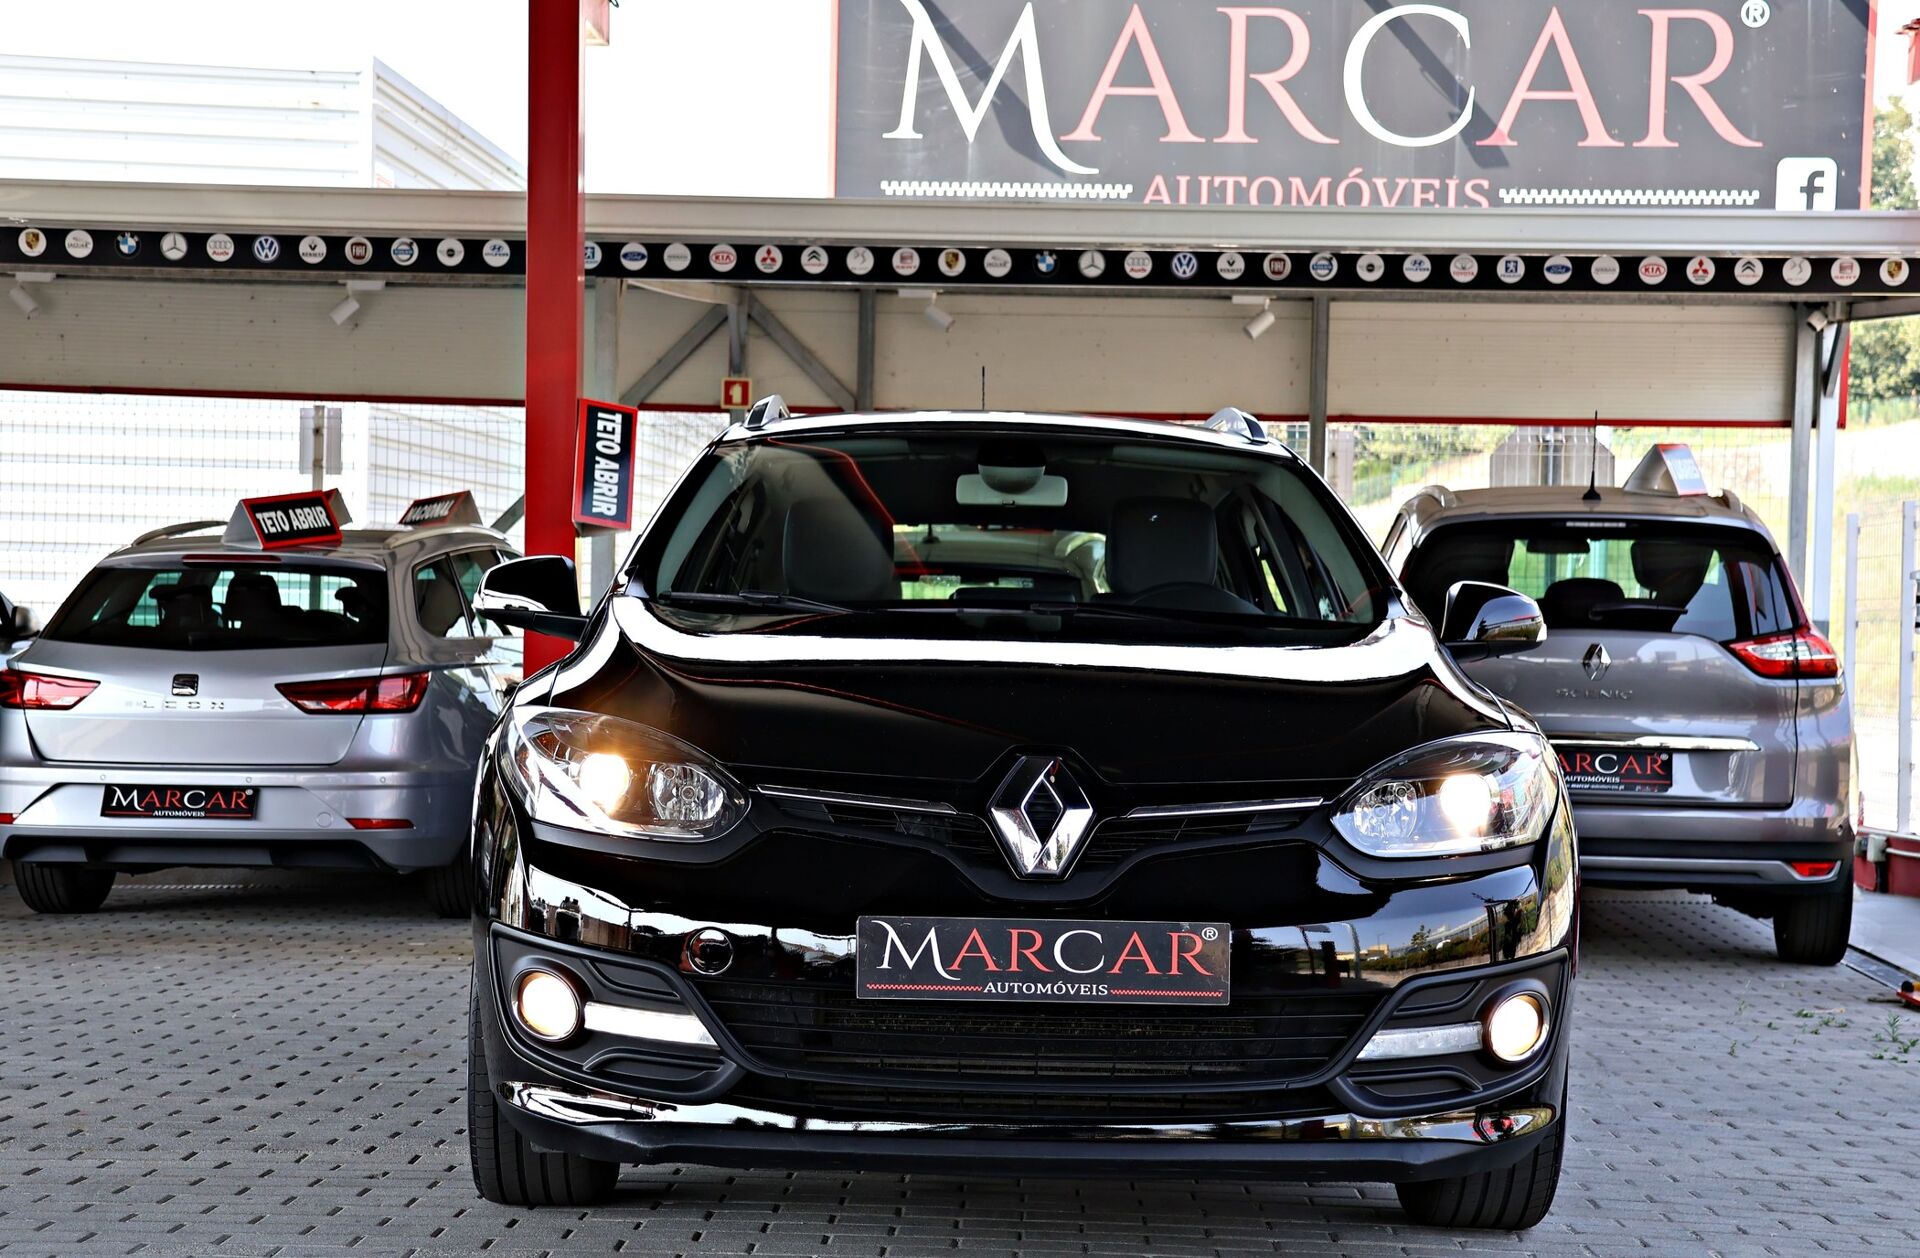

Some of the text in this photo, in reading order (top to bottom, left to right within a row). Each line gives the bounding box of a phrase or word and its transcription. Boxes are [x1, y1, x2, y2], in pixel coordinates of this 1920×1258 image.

[714, 254, 732, 262] KIA
[1644, 266, 1662, 274] KIA
[592, 412, 622, 516] TETO ABRIR
[256, 506, 331, 534] TETO ABRIR
[152, 810, 206, 818] AUTOMÓVEIS
[983, 980, 1109, 996] AUTOMÓVEIS
